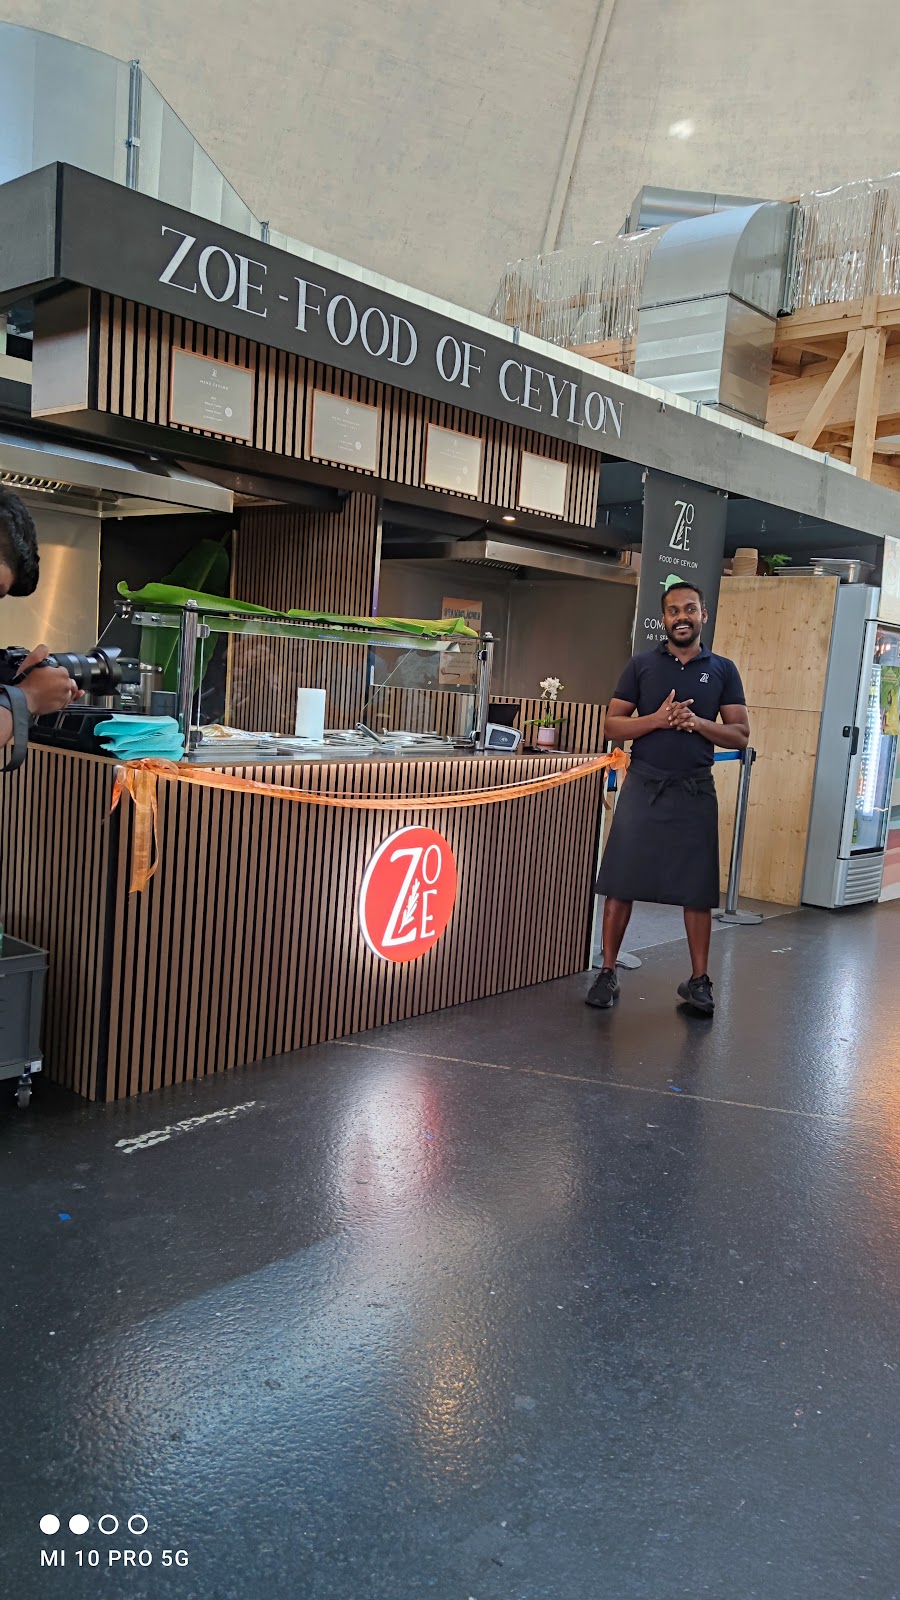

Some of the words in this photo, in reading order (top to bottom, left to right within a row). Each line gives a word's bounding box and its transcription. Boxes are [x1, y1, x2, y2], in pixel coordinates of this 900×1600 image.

[436, 336, 486, 388] OF
[498, 360, 625, 439] CEYLON
[659, 554, 673, 564] FOOD
[673, 557, 680, 565] OF
[681, 559, 699, 569] CEYLON
[644, 617, 666, 630] COM
